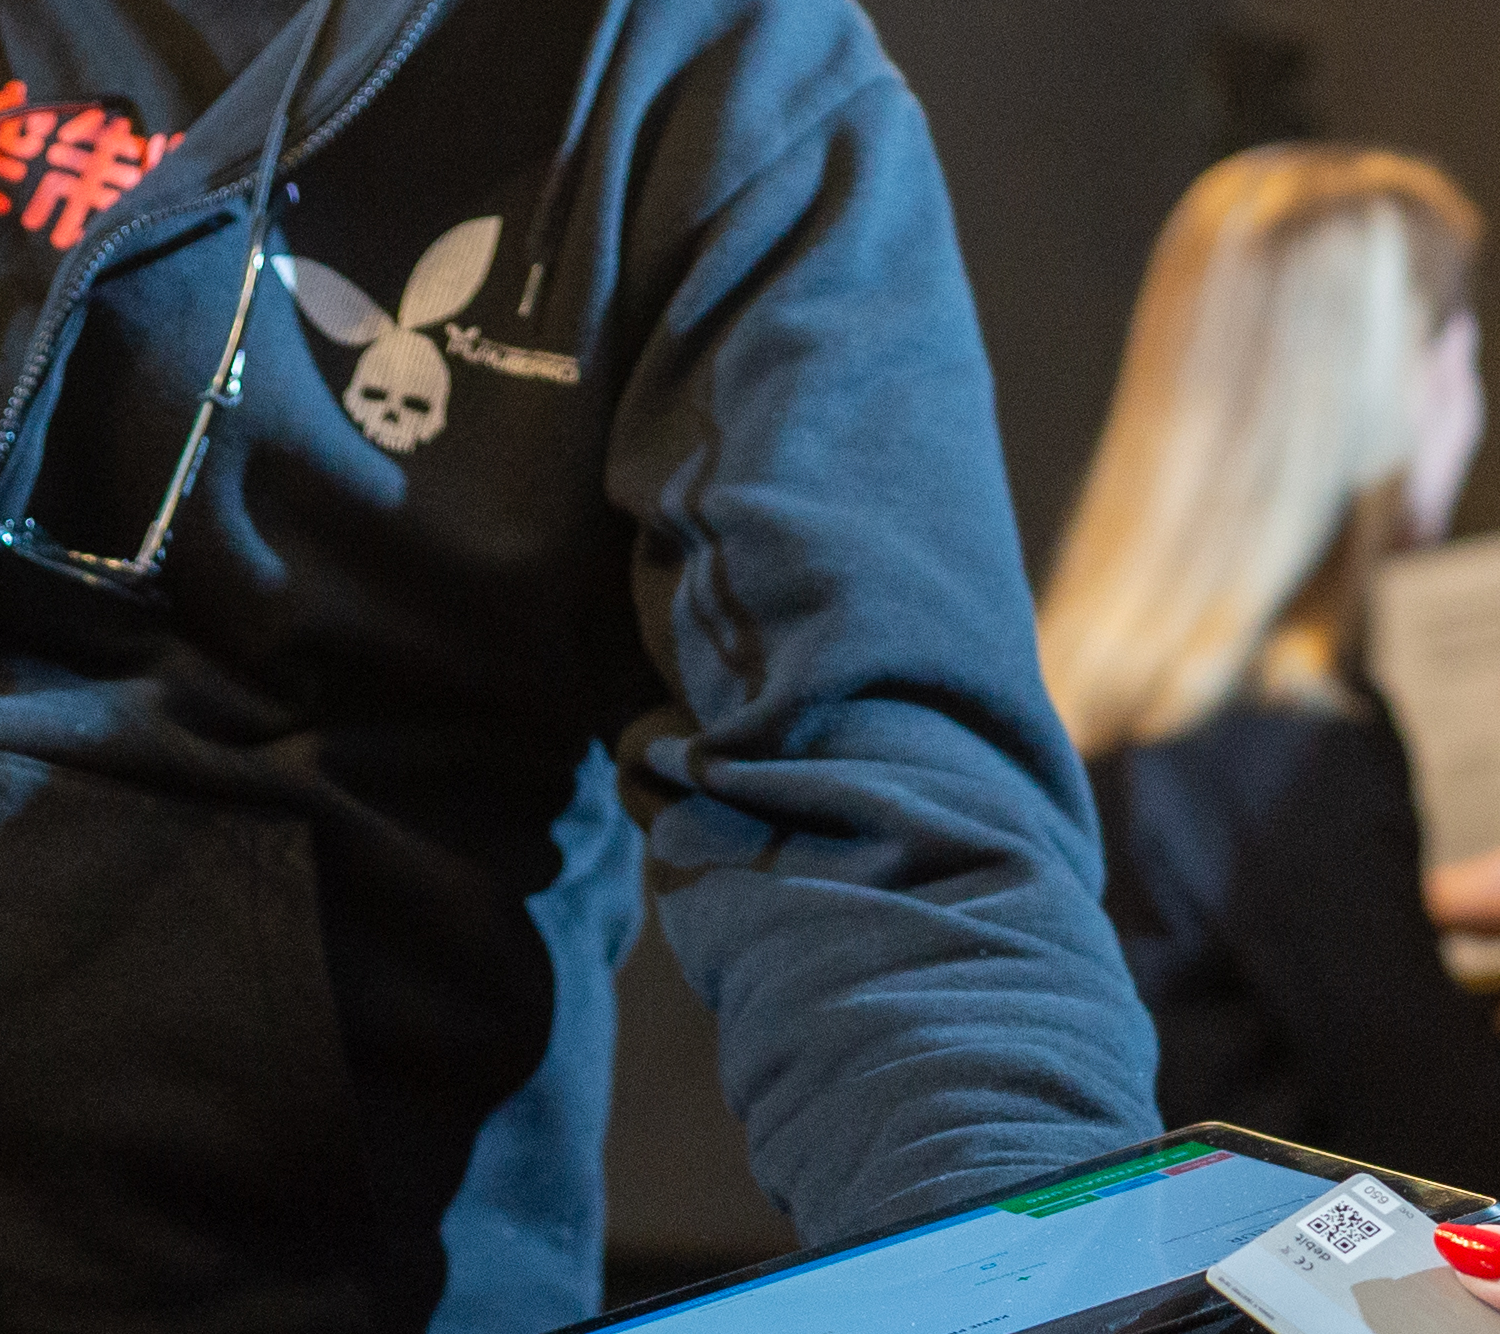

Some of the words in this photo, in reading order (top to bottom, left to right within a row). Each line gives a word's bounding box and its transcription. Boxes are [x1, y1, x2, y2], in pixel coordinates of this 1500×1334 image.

[1364, 1185, 1390, 1205] 650
[1293, 1233, 1331, 1262] debit
[970, 1315, 1008, 1328] KEINE
